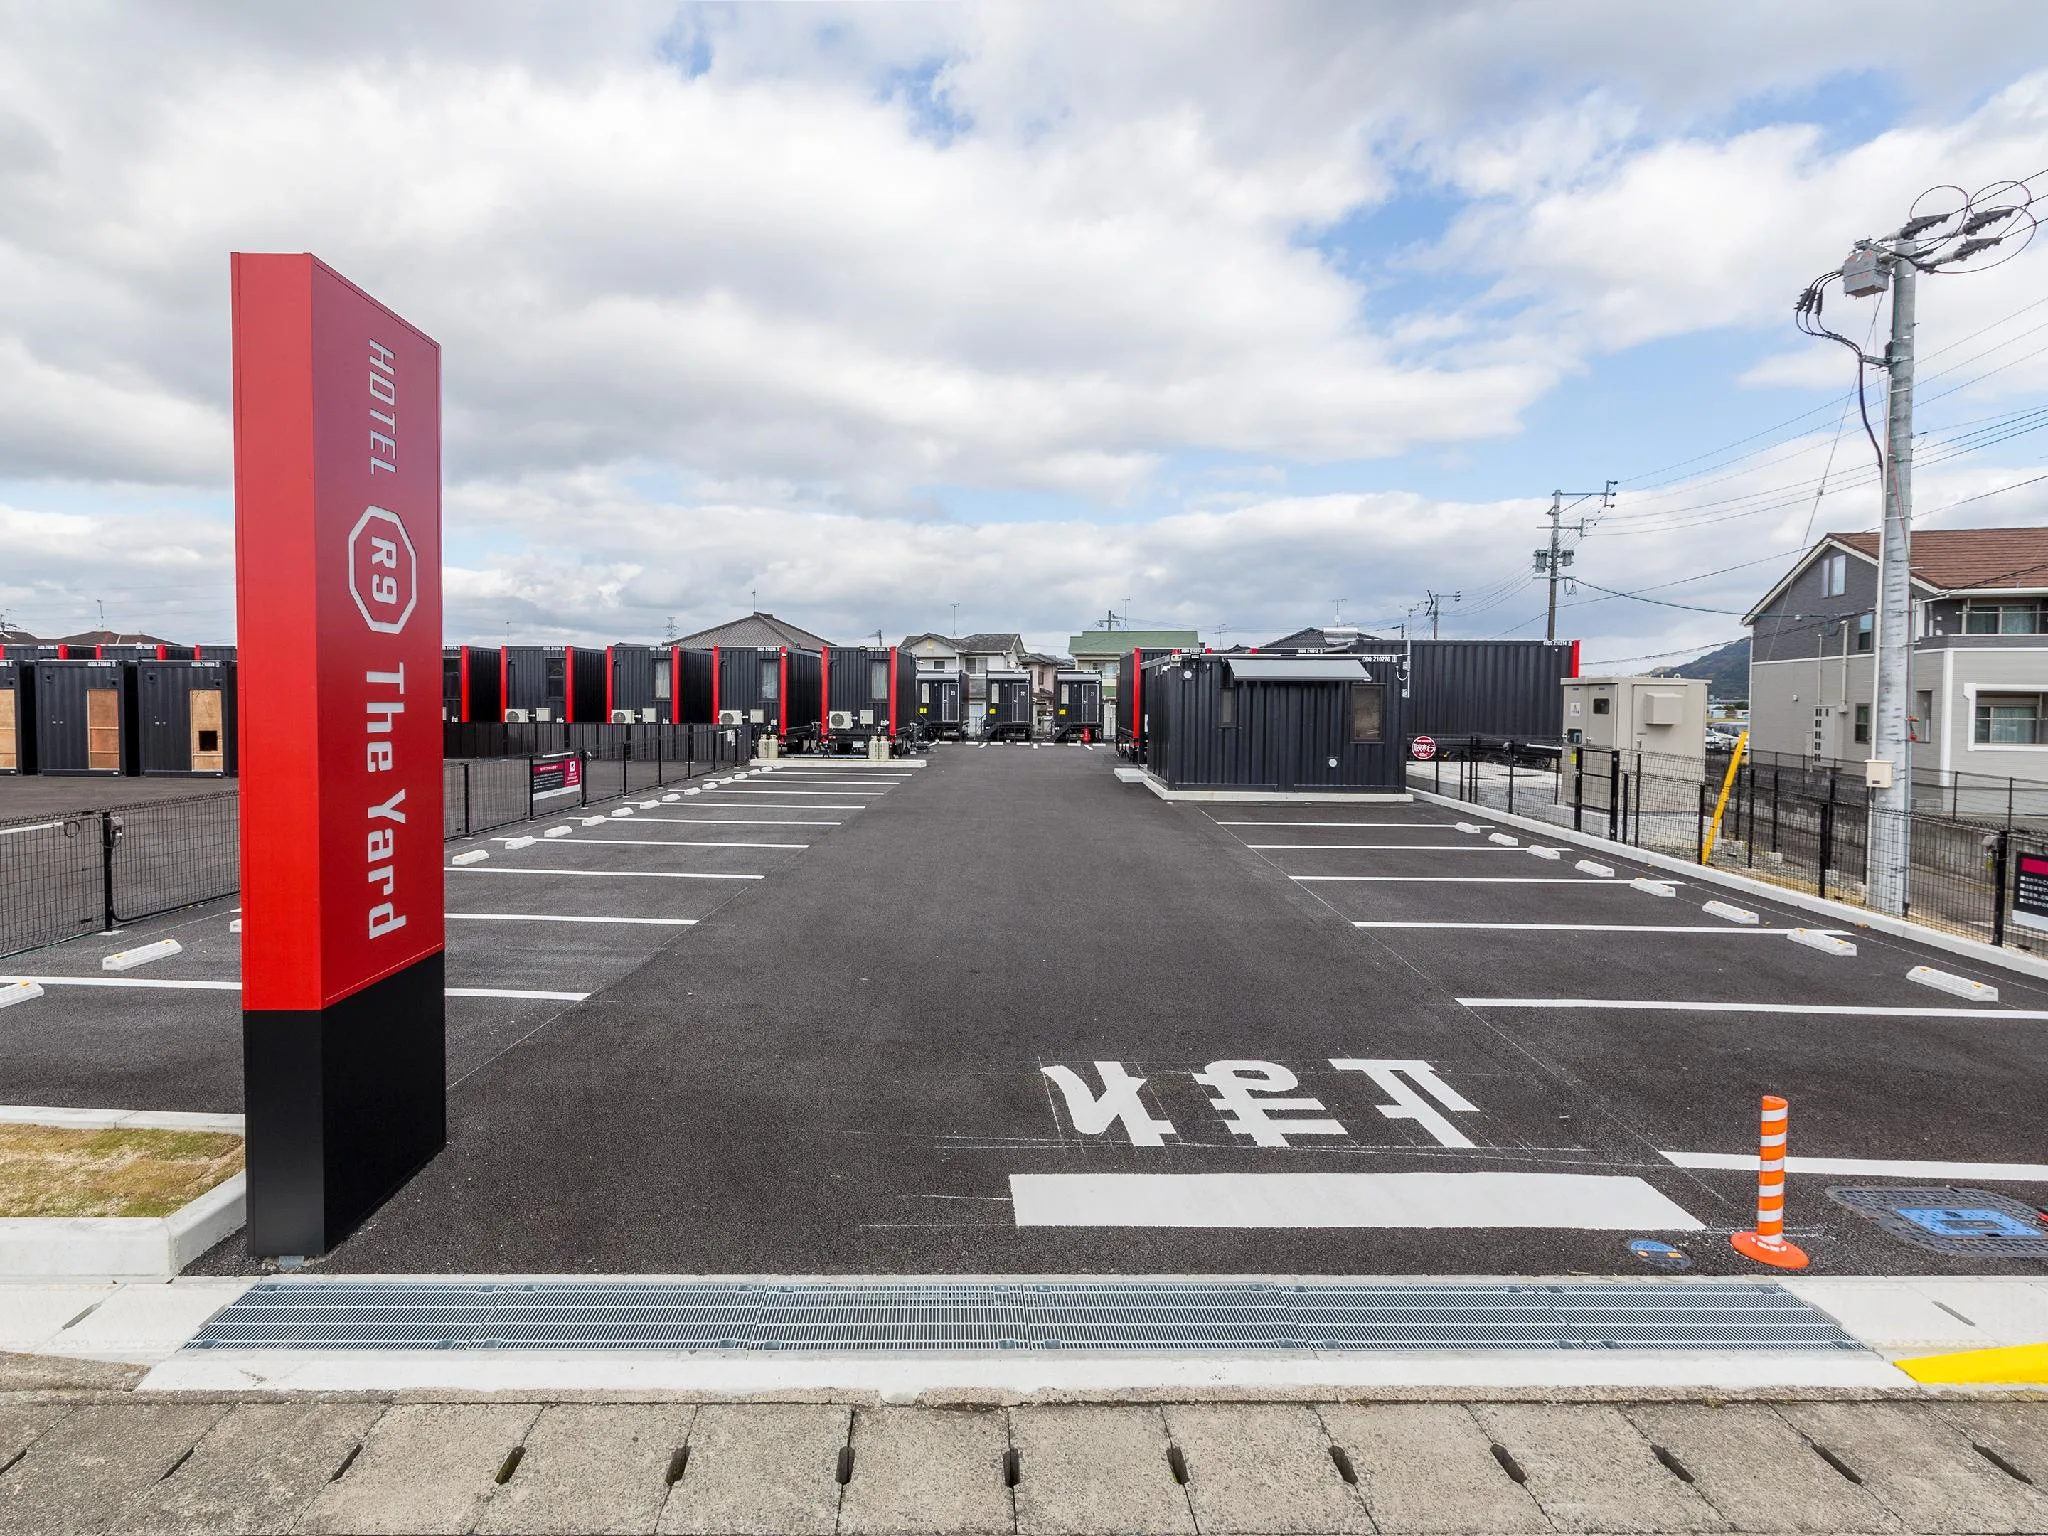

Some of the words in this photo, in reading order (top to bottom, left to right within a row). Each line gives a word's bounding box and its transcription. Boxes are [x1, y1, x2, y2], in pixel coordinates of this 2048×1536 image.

[369, 337, 397, 475] HOTEL
[371, 536, 398, 605] R9
[366, 661, 405, 773] The
[368, 788, 407, 940] Yard
[1040, 1058, 1480, 1148] 止まれ
